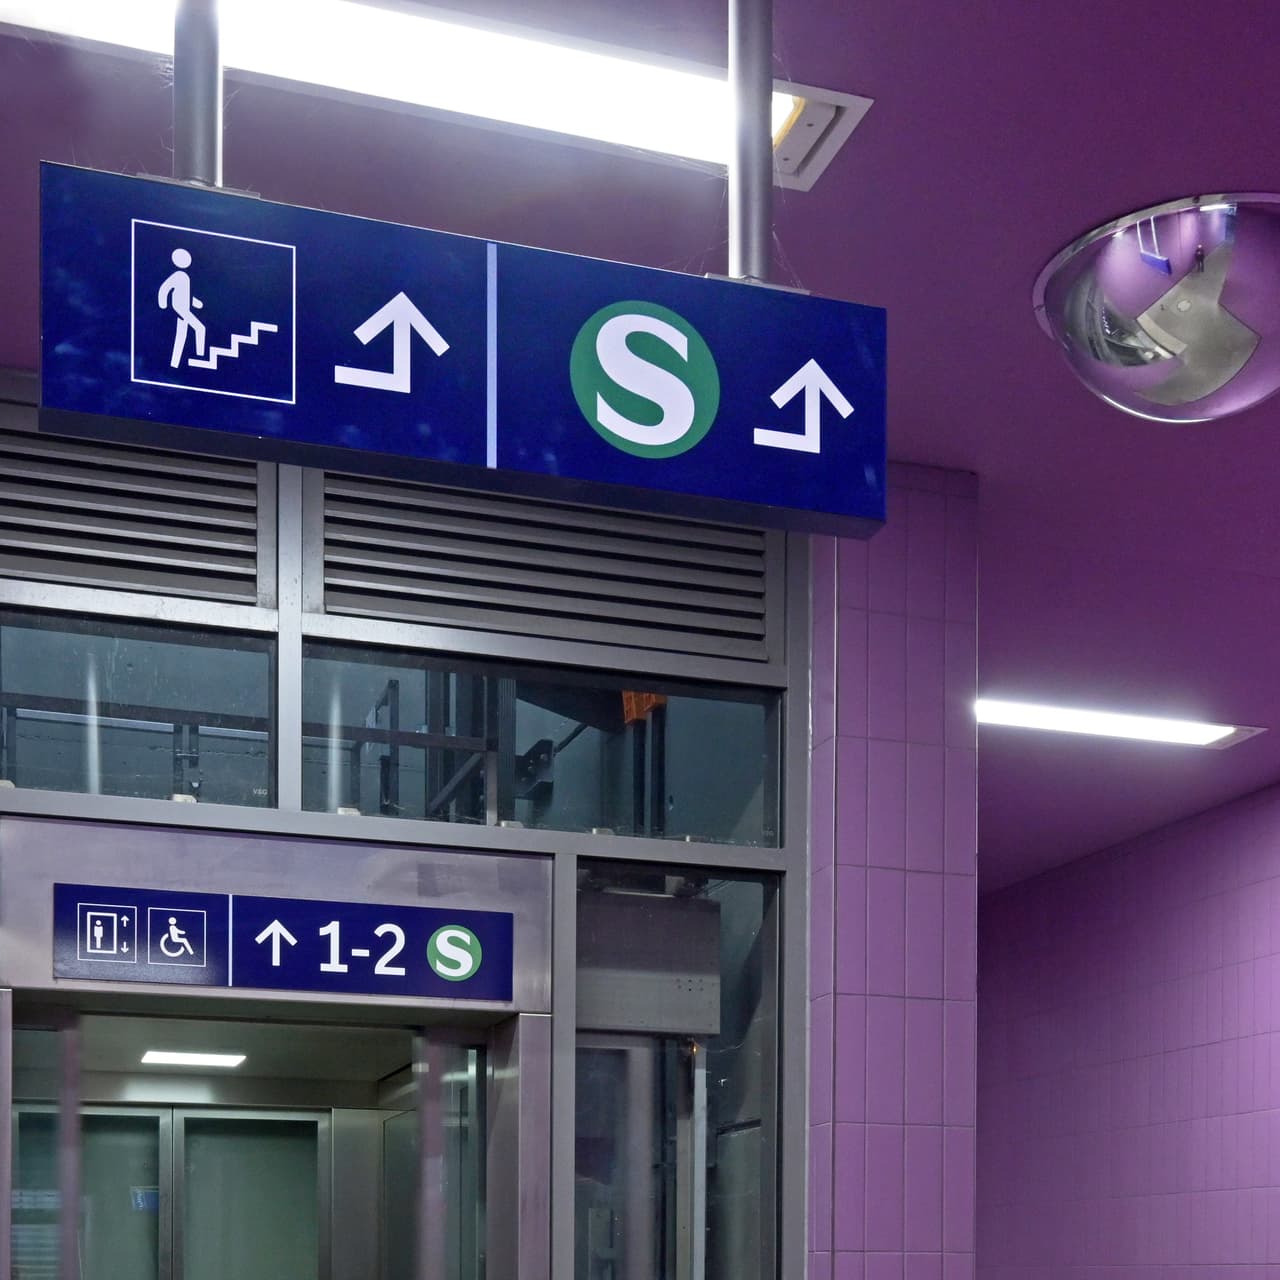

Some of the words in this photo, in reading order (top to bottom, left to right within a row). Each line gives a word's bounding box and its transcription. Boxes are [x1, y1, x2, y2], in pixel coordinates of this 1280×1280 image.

[595, 314, 696, 446] S
[319, 920, 406, 976] 1-2
[434, 929, 475, 978] S
